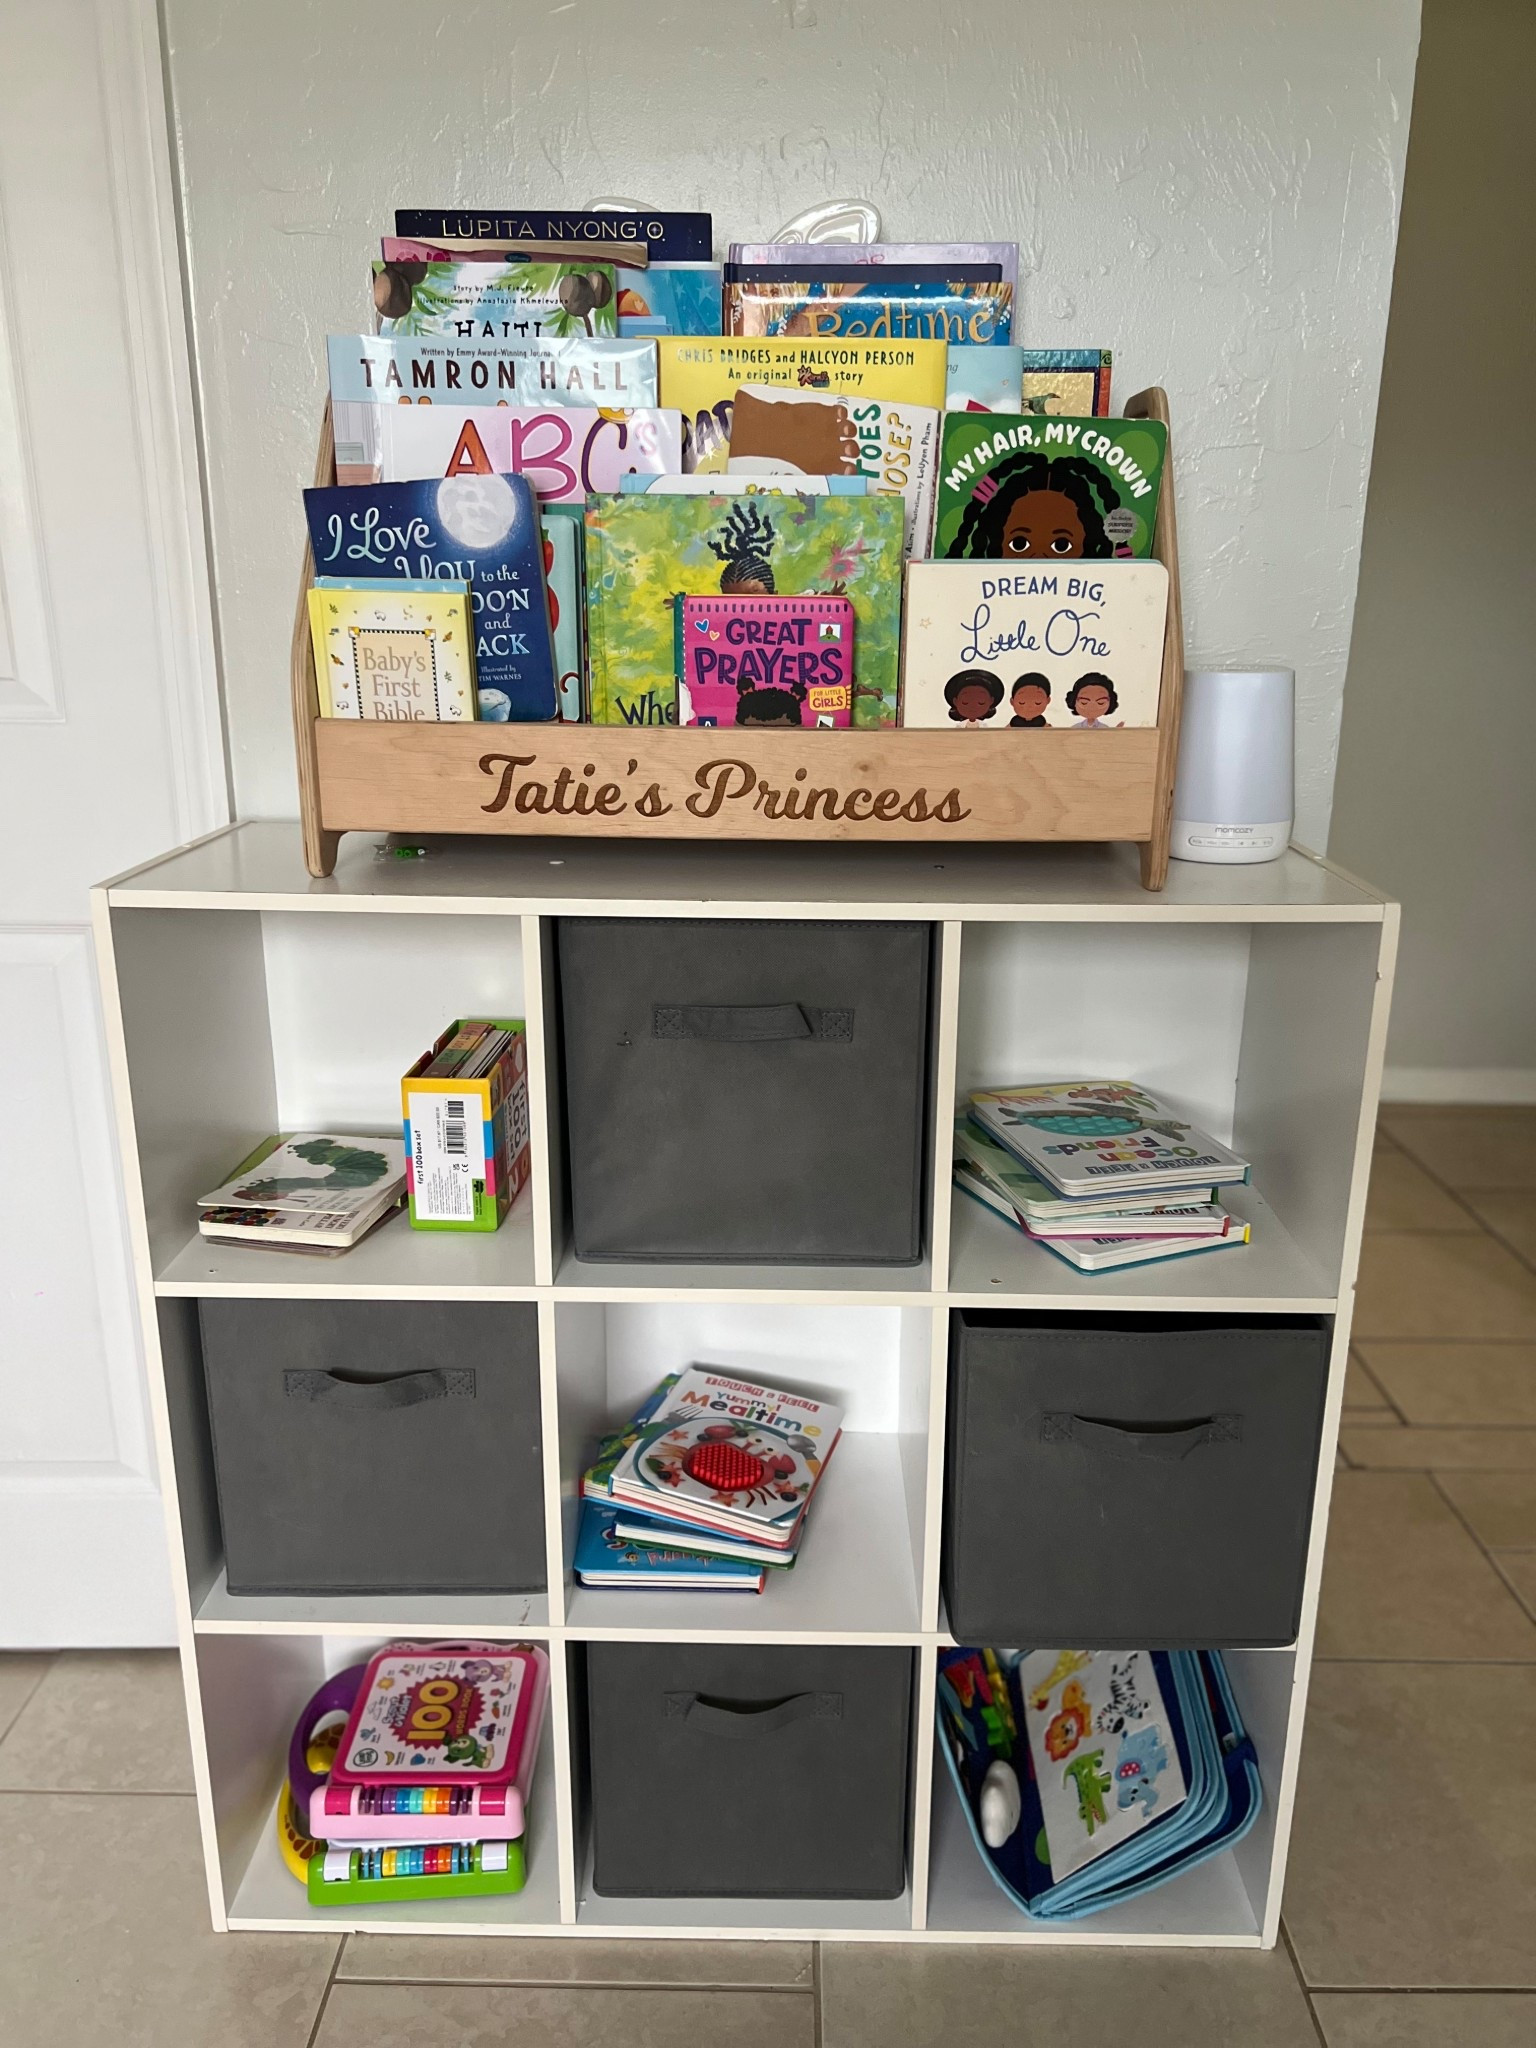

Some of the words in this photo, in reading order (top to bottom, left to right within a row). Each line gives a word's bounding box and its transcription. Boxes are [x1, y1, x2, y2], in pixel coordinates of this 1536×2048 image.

[442, 219, 535, 238] LUPITA
[548, 221, 664, 240] NYONG'O
[453, 285, 472, 293] Story
[454, 320, 542, 338] HAITI
[803, 300, 995, 343] Bedtime
[421, 347, 445, 357] Written
[446, 348, 455, 357] by
[456, 348, 476, 358] Emmy
[477, 348, 527, 358] Award-Winning
[677, 349, 714, 363] CHRIS
[719, 350, 772, 364] BRIDGES
[775, 351, 796, 363] and
[800, 350, 858, 365] HALCYON
[865, 351, 915, 365] PERSON
[360, 358, 516, 389] TAMRON
[540, 361, 629, 390] HALL
[728, 368, 741, 380] An
[747, 368, 792, 384] original
[834, 370, 864, 386] story
[853, 402, 883, 479] TOES
[916, 482, 925, 492] by
[923, 422, 932, 449] Pham
[944, 456, 976, 492] MY
[973, 423, 1042, 465] HAIR,
[1045, 422, 1081, 444] MY
[1081, 430, 1153, 499] CROWN
[323, 513, 342, 562] I
[347, 506, 437, 563] Love
[481, 570, 494, 582] to
[496, 564, 520, 581] the
[472, 588, 530, 614] OON
[982, 576, 1058, 600] DREAM
[1067, 578, 1106, 607] BIG,
[484, 612, 512, 630] and
[726, 618, 813, 646] GREAT
[960, 603, 1041, 663] Little
[1045, 609, 1111, 657] One
[476, 633, 530, 657] ACK
[363, 647, 427, 674] Baby's
[481, 665, 508, 673] Illustrated
[509, 665, 517, 673] by
[694, 647, 843, 685] PRAYERS
[373, 675, 421, 698] First
[824, 688, 842, 696] LITTLE
[374, 700, 426, 721] Bible
[614, 691, 676, 726] Whe
[478, 753, 673, 818] Tatie's
[685, 758, 972, 823] Princess
[512, 1090, 521, 1149] 100
[518, 1080, 527, 1138] first
[413, 1129, 421, 1141] set
[1042, 1136, 1161, 1156] Friends
[415, 1142, 423, 1155] box
[1097, 1146, 1199, 1163] Ocean
[415, 1154, 424, 1169] 100
[1084, 1163, 1140, 1175] FEEL
[1149, 1156, 1222, 1169] TOUCH
[416, 1170, 424, 1185] first
[704, 1376, 765, 1397] TOUCH
[777, 1393, 821, 1413] FEEL
[716, 1391, 781, 1412] Yummy!
[681, 1390, 822, 1437] Mealtime
[406, 1680, 460, 1740] 100
[461, 1688, 474, 1711] BOOK
